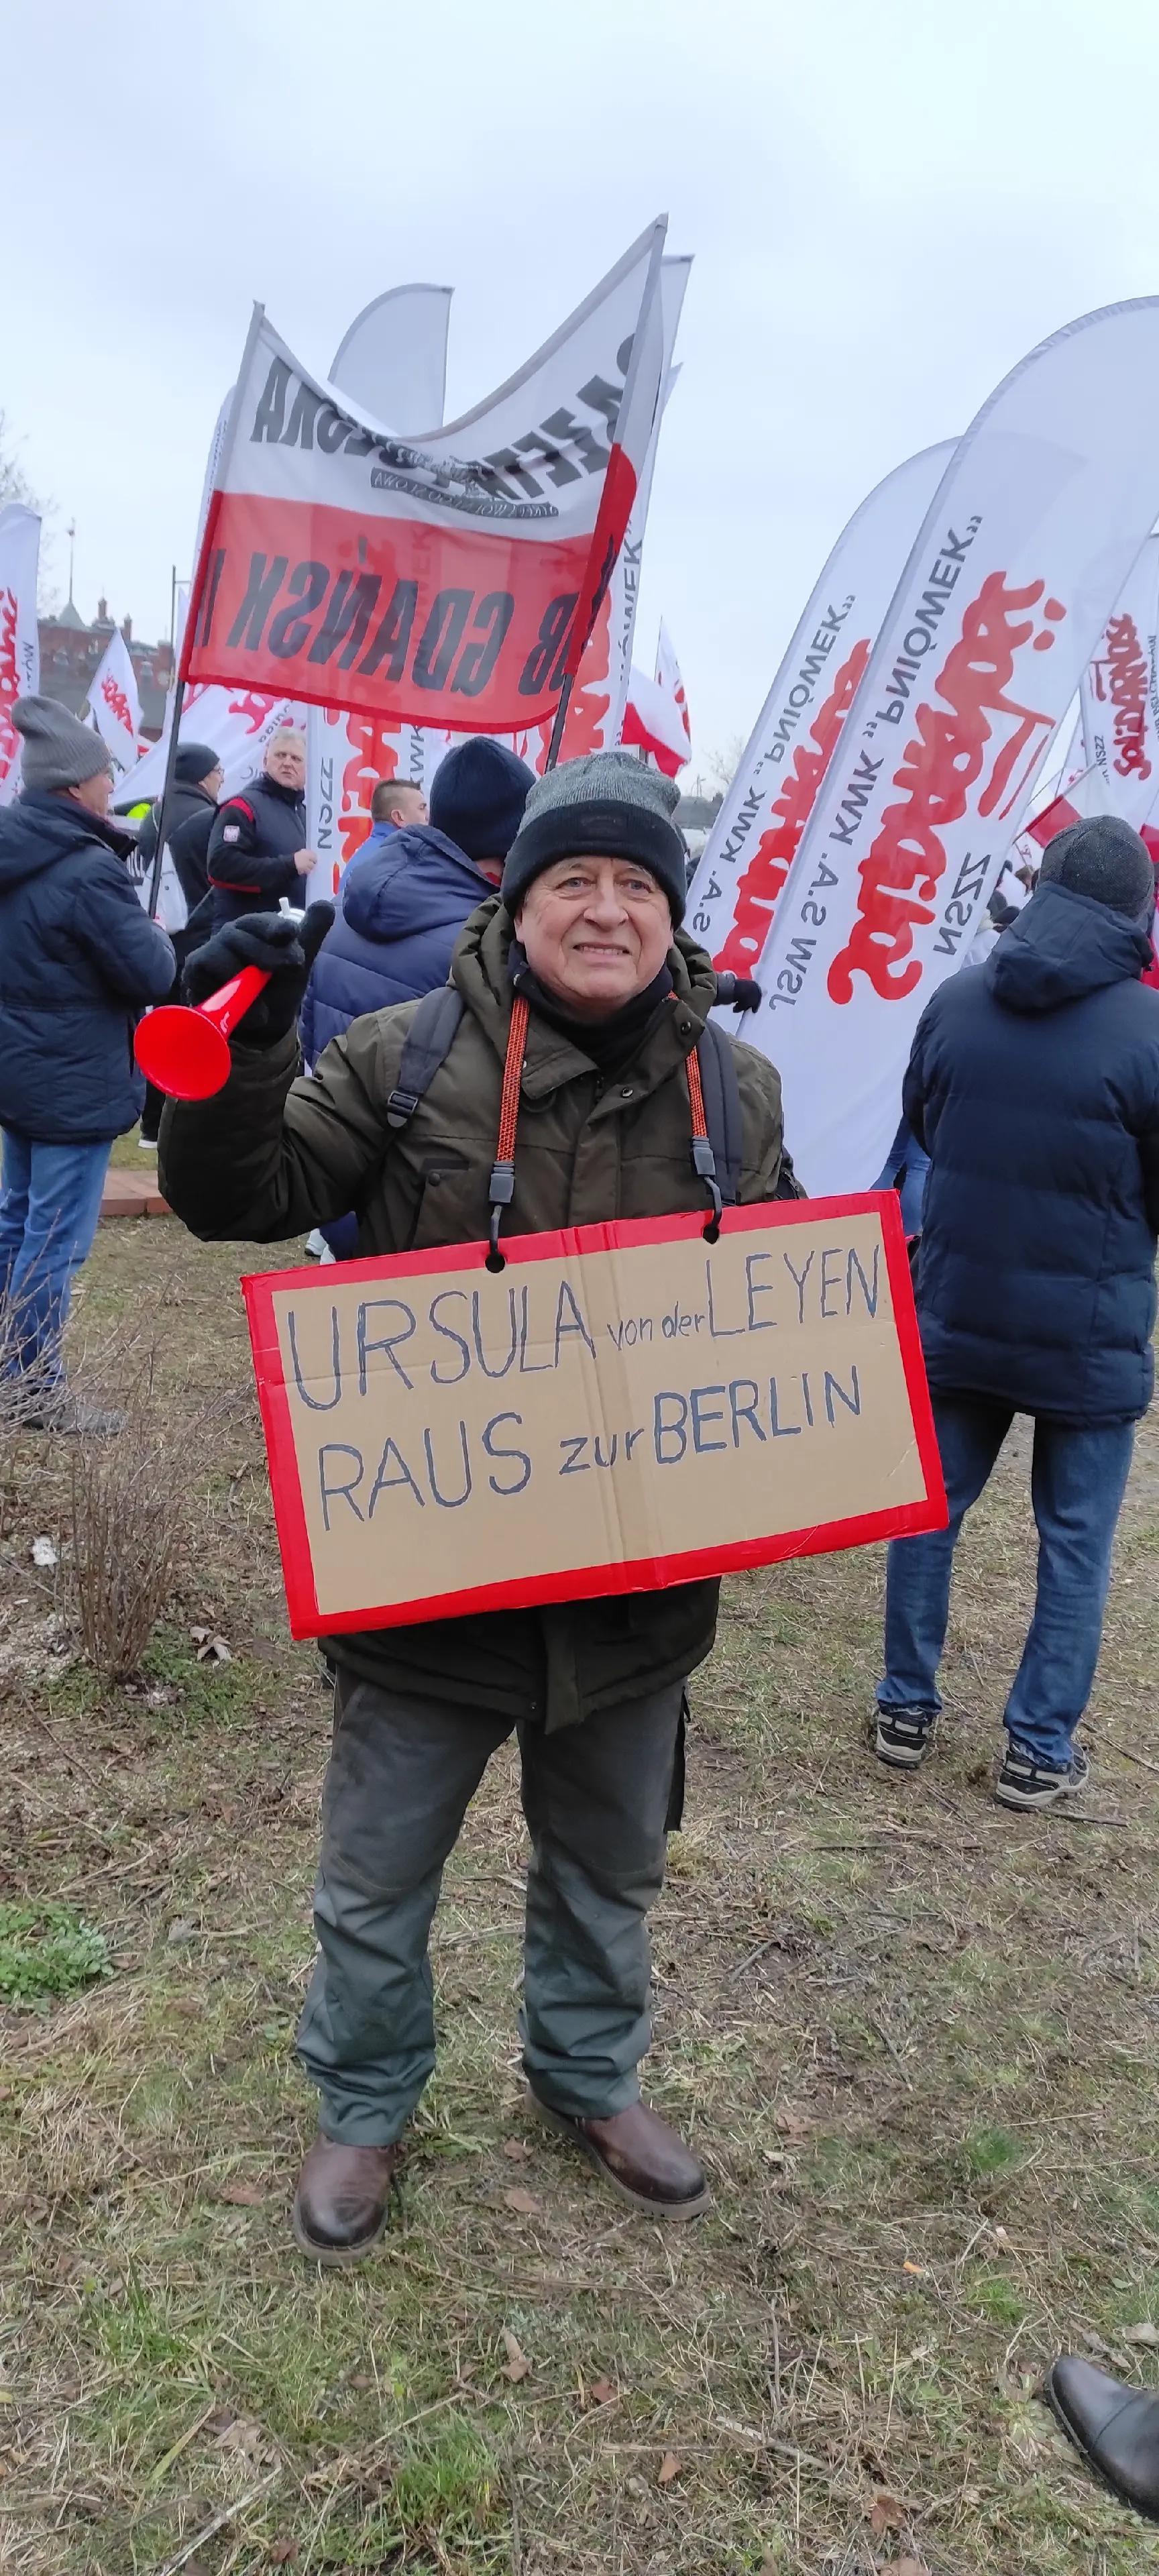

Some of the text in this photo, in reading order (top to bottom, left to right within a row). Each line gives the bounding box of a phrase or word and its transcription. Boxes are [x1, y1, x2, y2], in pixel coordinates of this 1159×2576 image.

[288, 1244, 880, 1410] URSULA von der LEYEN
[319, 1364, 861, 1532] RAUS zur BERLIN
